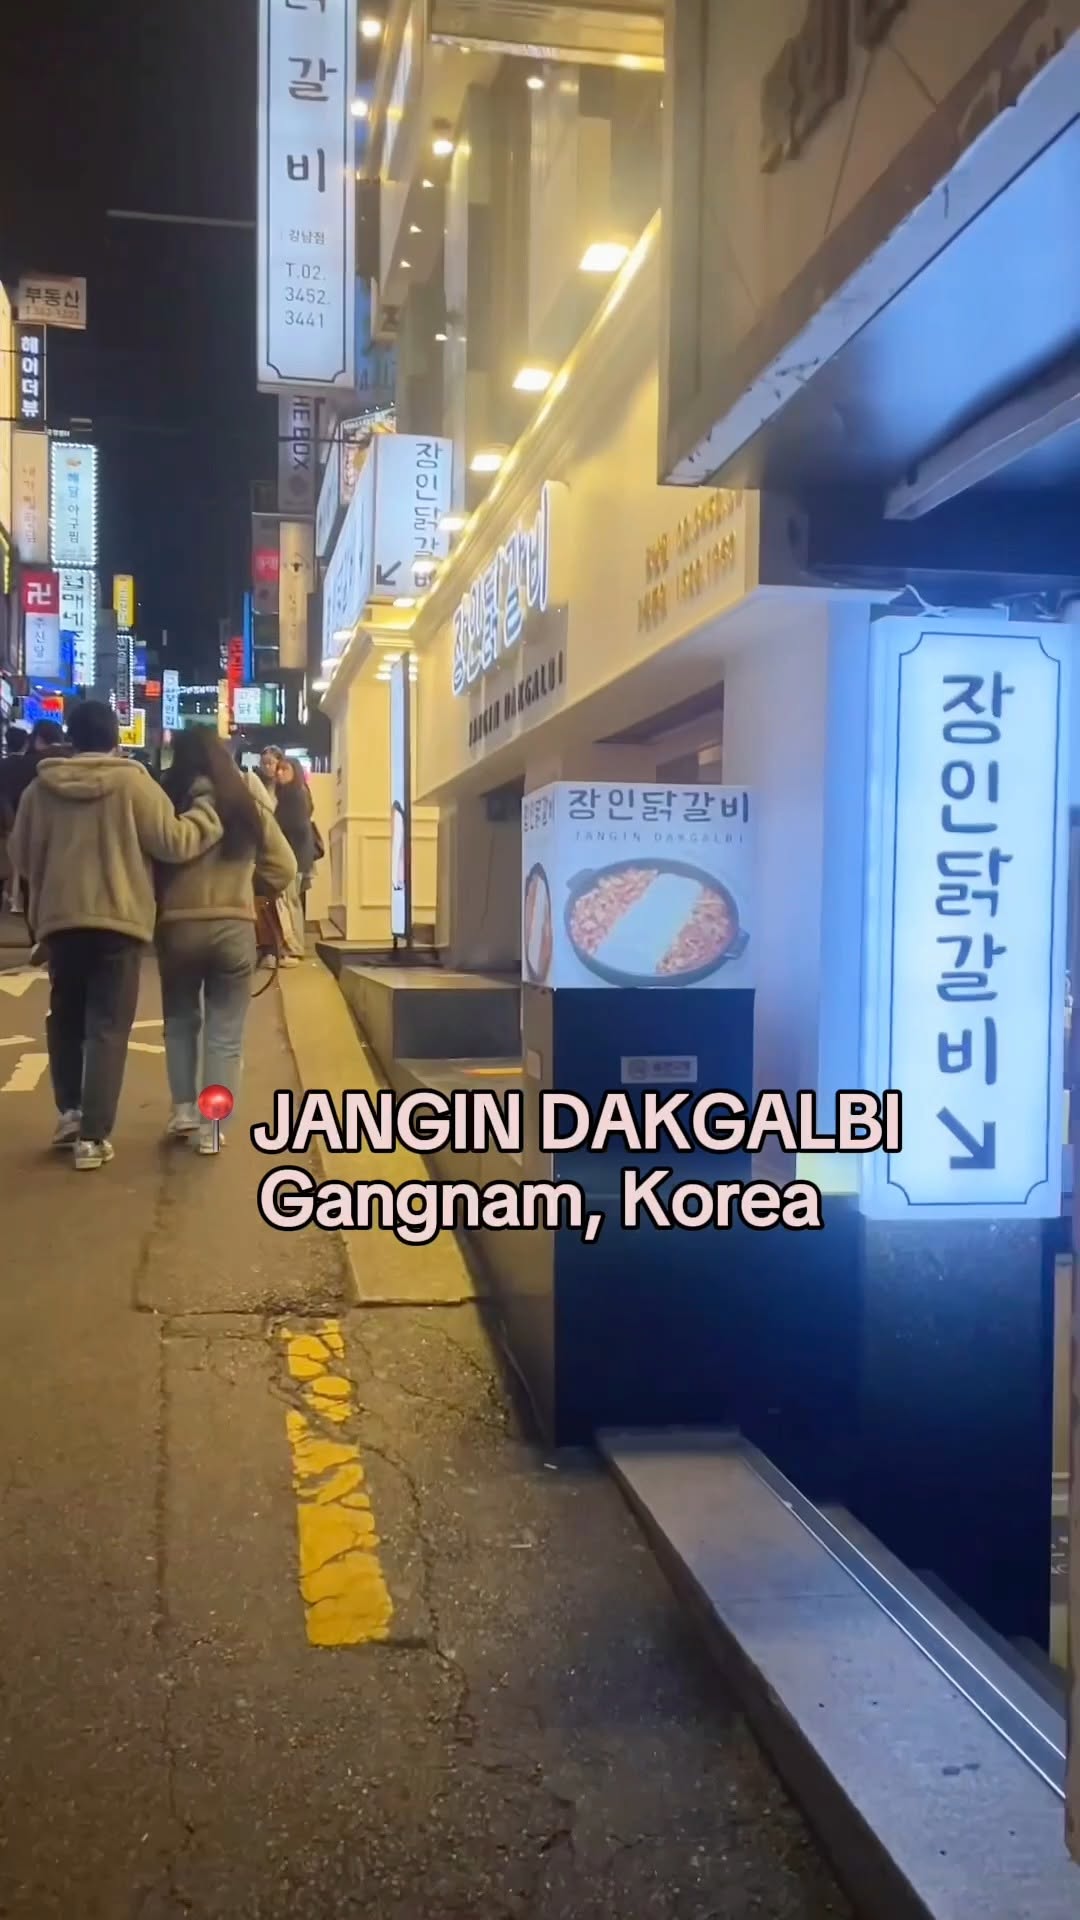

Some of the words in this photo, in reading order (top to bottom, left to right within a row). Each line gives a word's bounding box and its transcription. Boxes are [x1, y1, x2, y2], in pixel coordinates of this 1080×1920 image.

[26, 287, 79, 309] 부동산
[285, 310, 325, 329] 3441
[567, 788, 750, 824] 장인닭갈비
[575, 830, 641, 844] JANGIN
[936, 671, 1016, 1086] 장인닭갈비
